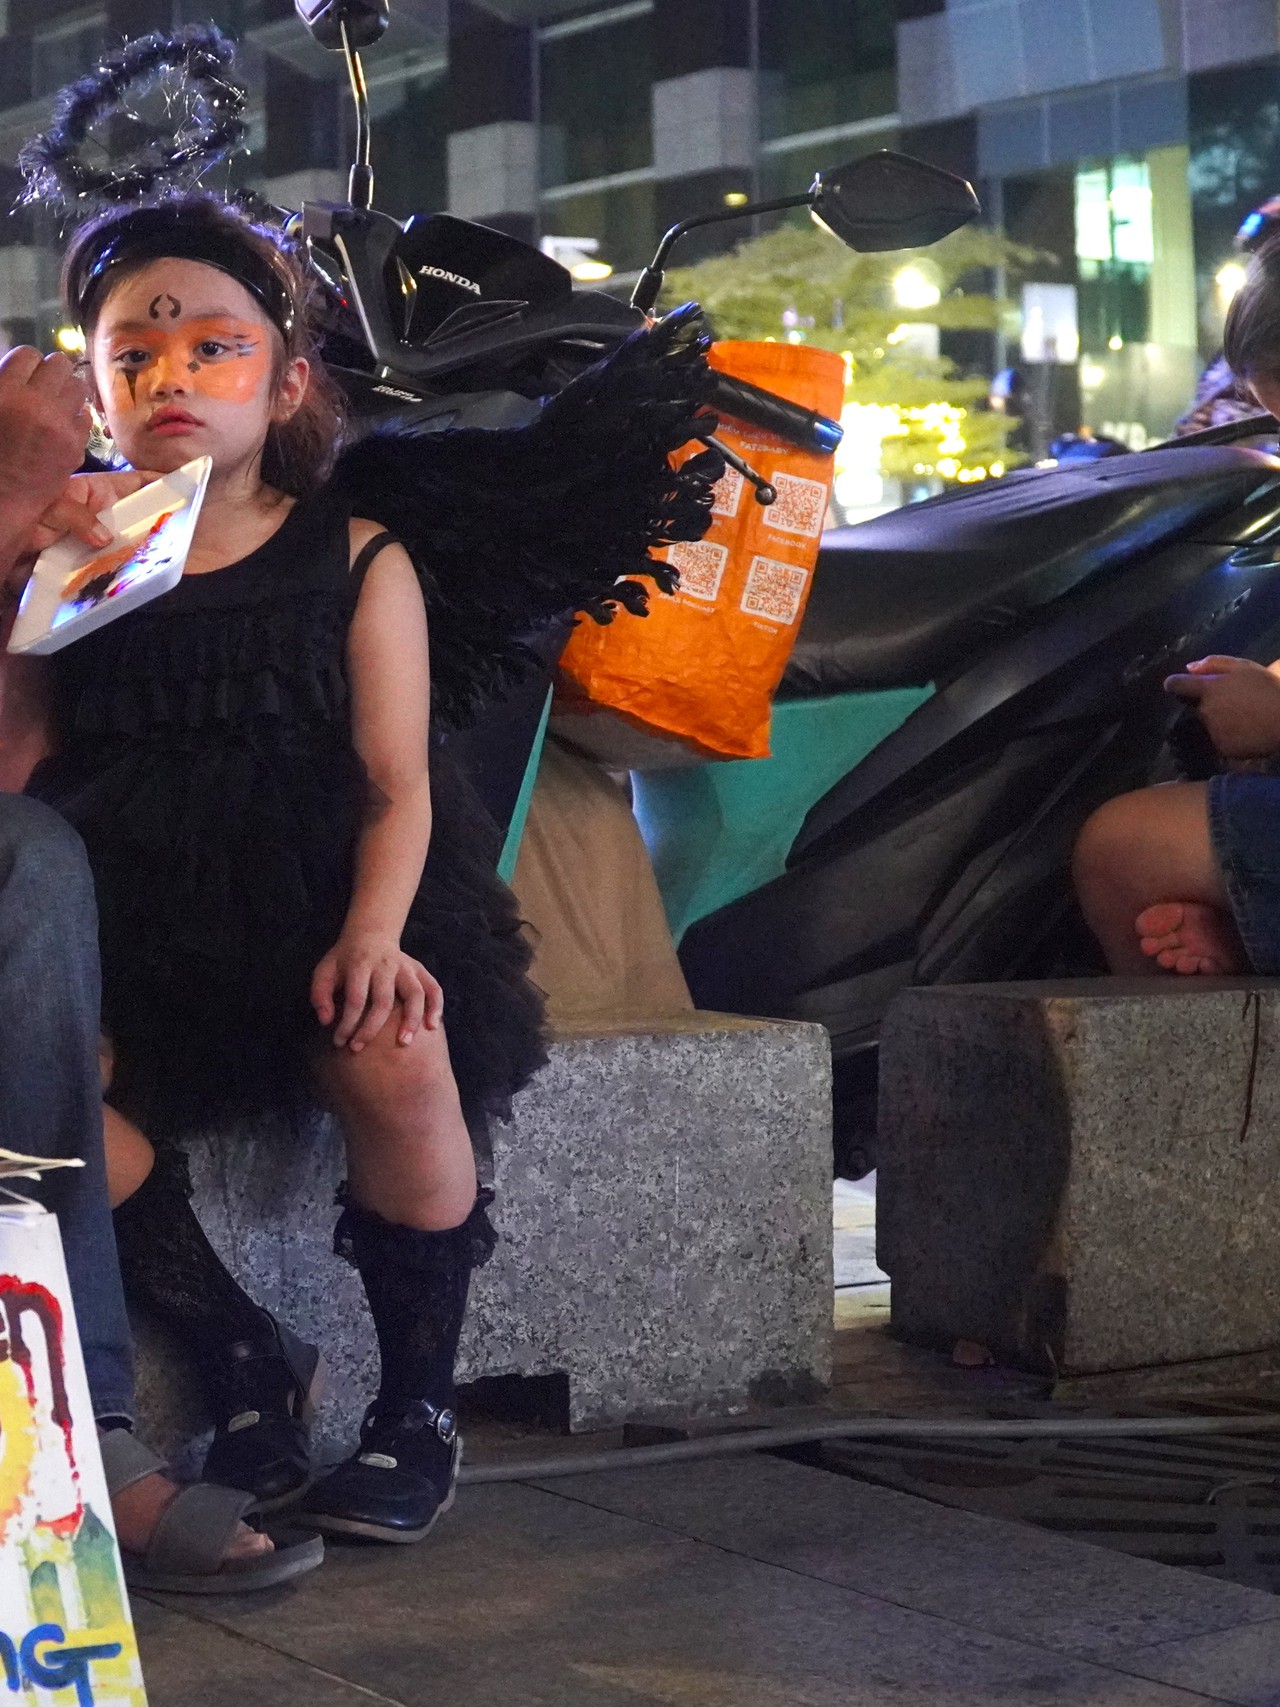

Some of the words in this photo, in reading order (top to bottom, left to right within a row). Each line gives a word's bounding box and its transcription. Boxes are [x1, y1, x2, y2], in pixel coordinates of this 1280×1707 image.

[419, 264, 482, 296] HONDA
[767, 534, 807, 549] FACEBOOK
[753, 620, 779, 636] TIKTOK
